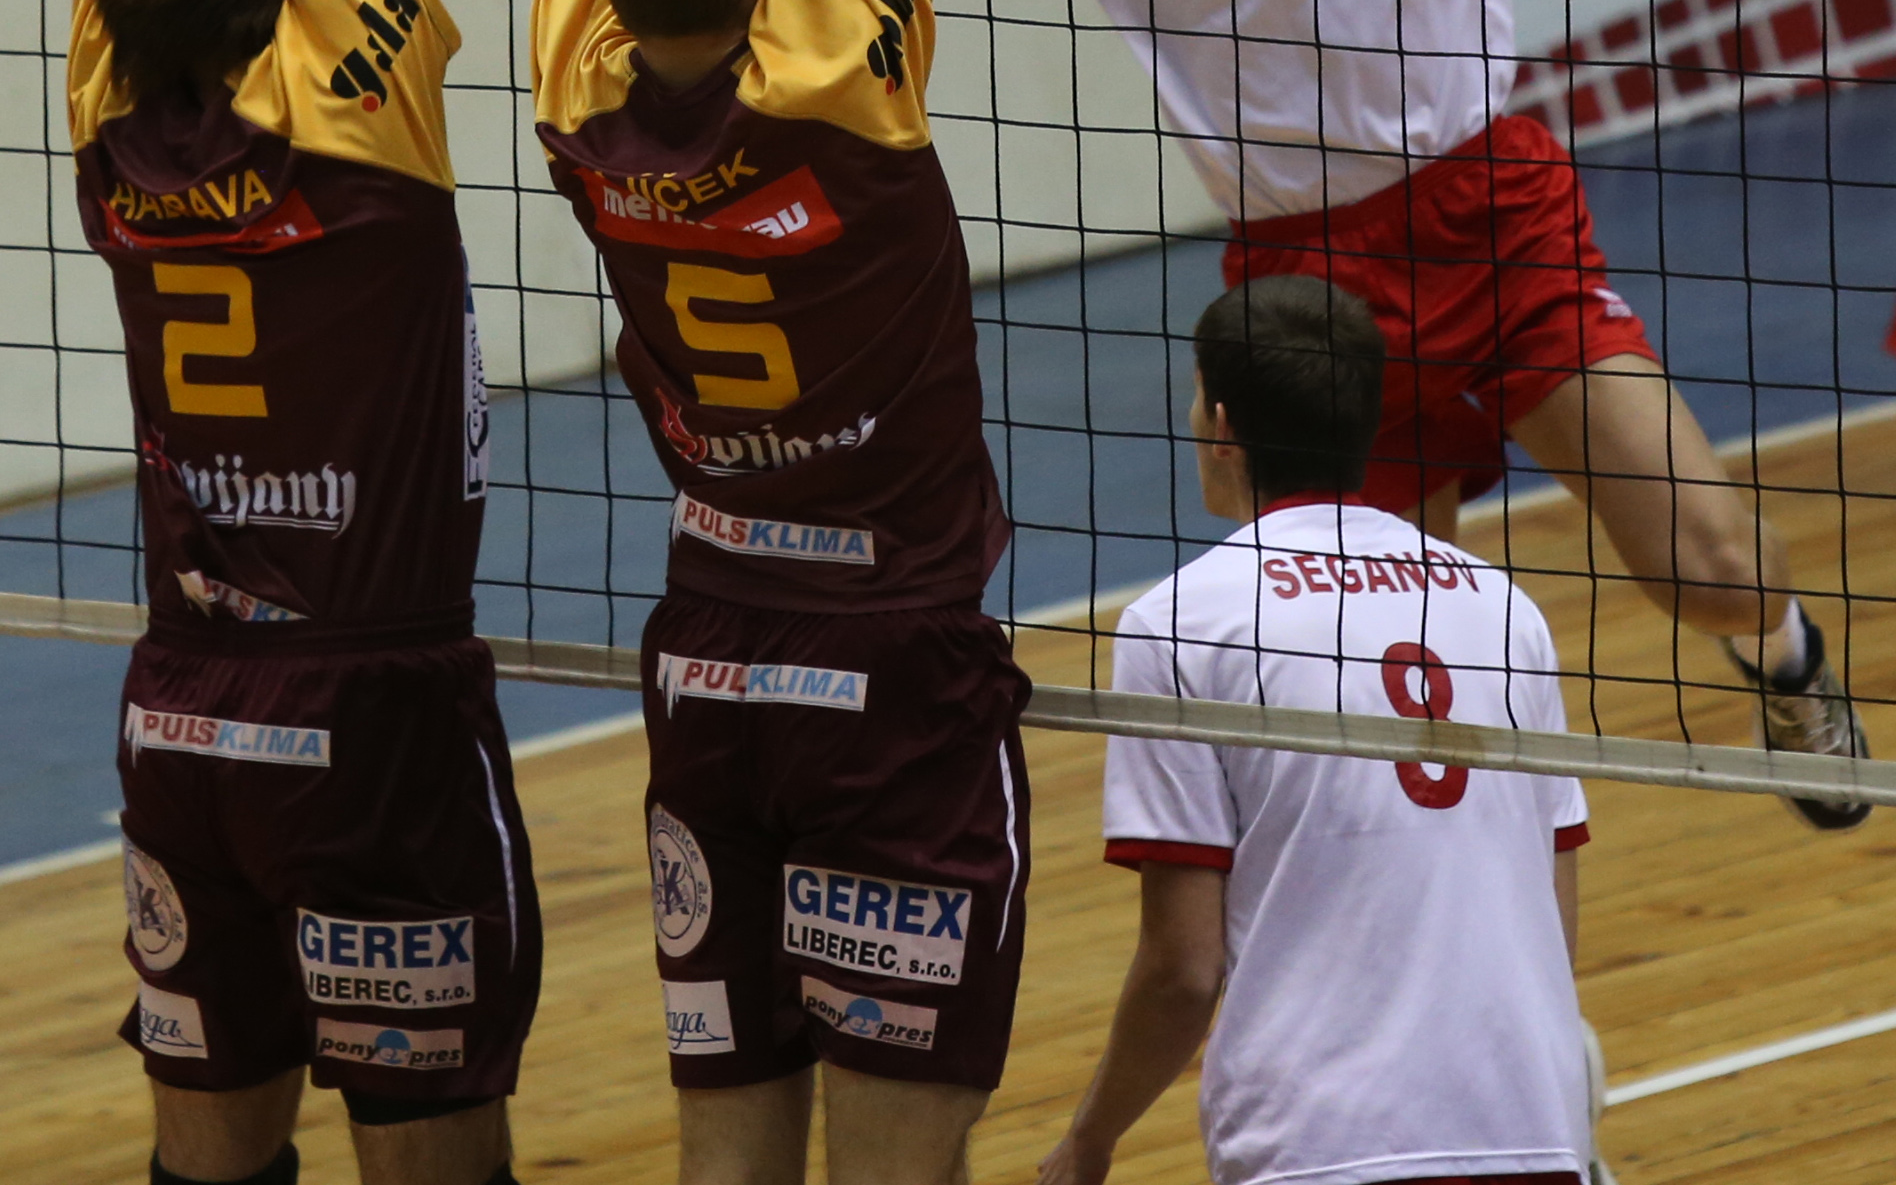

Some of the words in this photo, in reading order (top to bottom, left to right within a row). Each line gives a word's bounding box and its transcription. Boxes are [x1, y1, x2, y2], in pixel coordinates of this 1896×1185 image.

[152, 262, 268, 417] 2
[664, 262, 799, 411] 5
[682, 500, 866, 557] PULSKLIMA
[1263, 550, 1481, 600] SEGANOV
[1381, 641, 1470, 809] 8
[787, 868, 969, 941] GEREX
[299, 913, 472, 969] GEREX
[787, 922, 901, 975] LIBEREC,
[908, 957, 957, 979] s.r.o.
[309, 971, 417, 1006] IBEREC,
[425, 985, 471, 1002] s.r.o.
